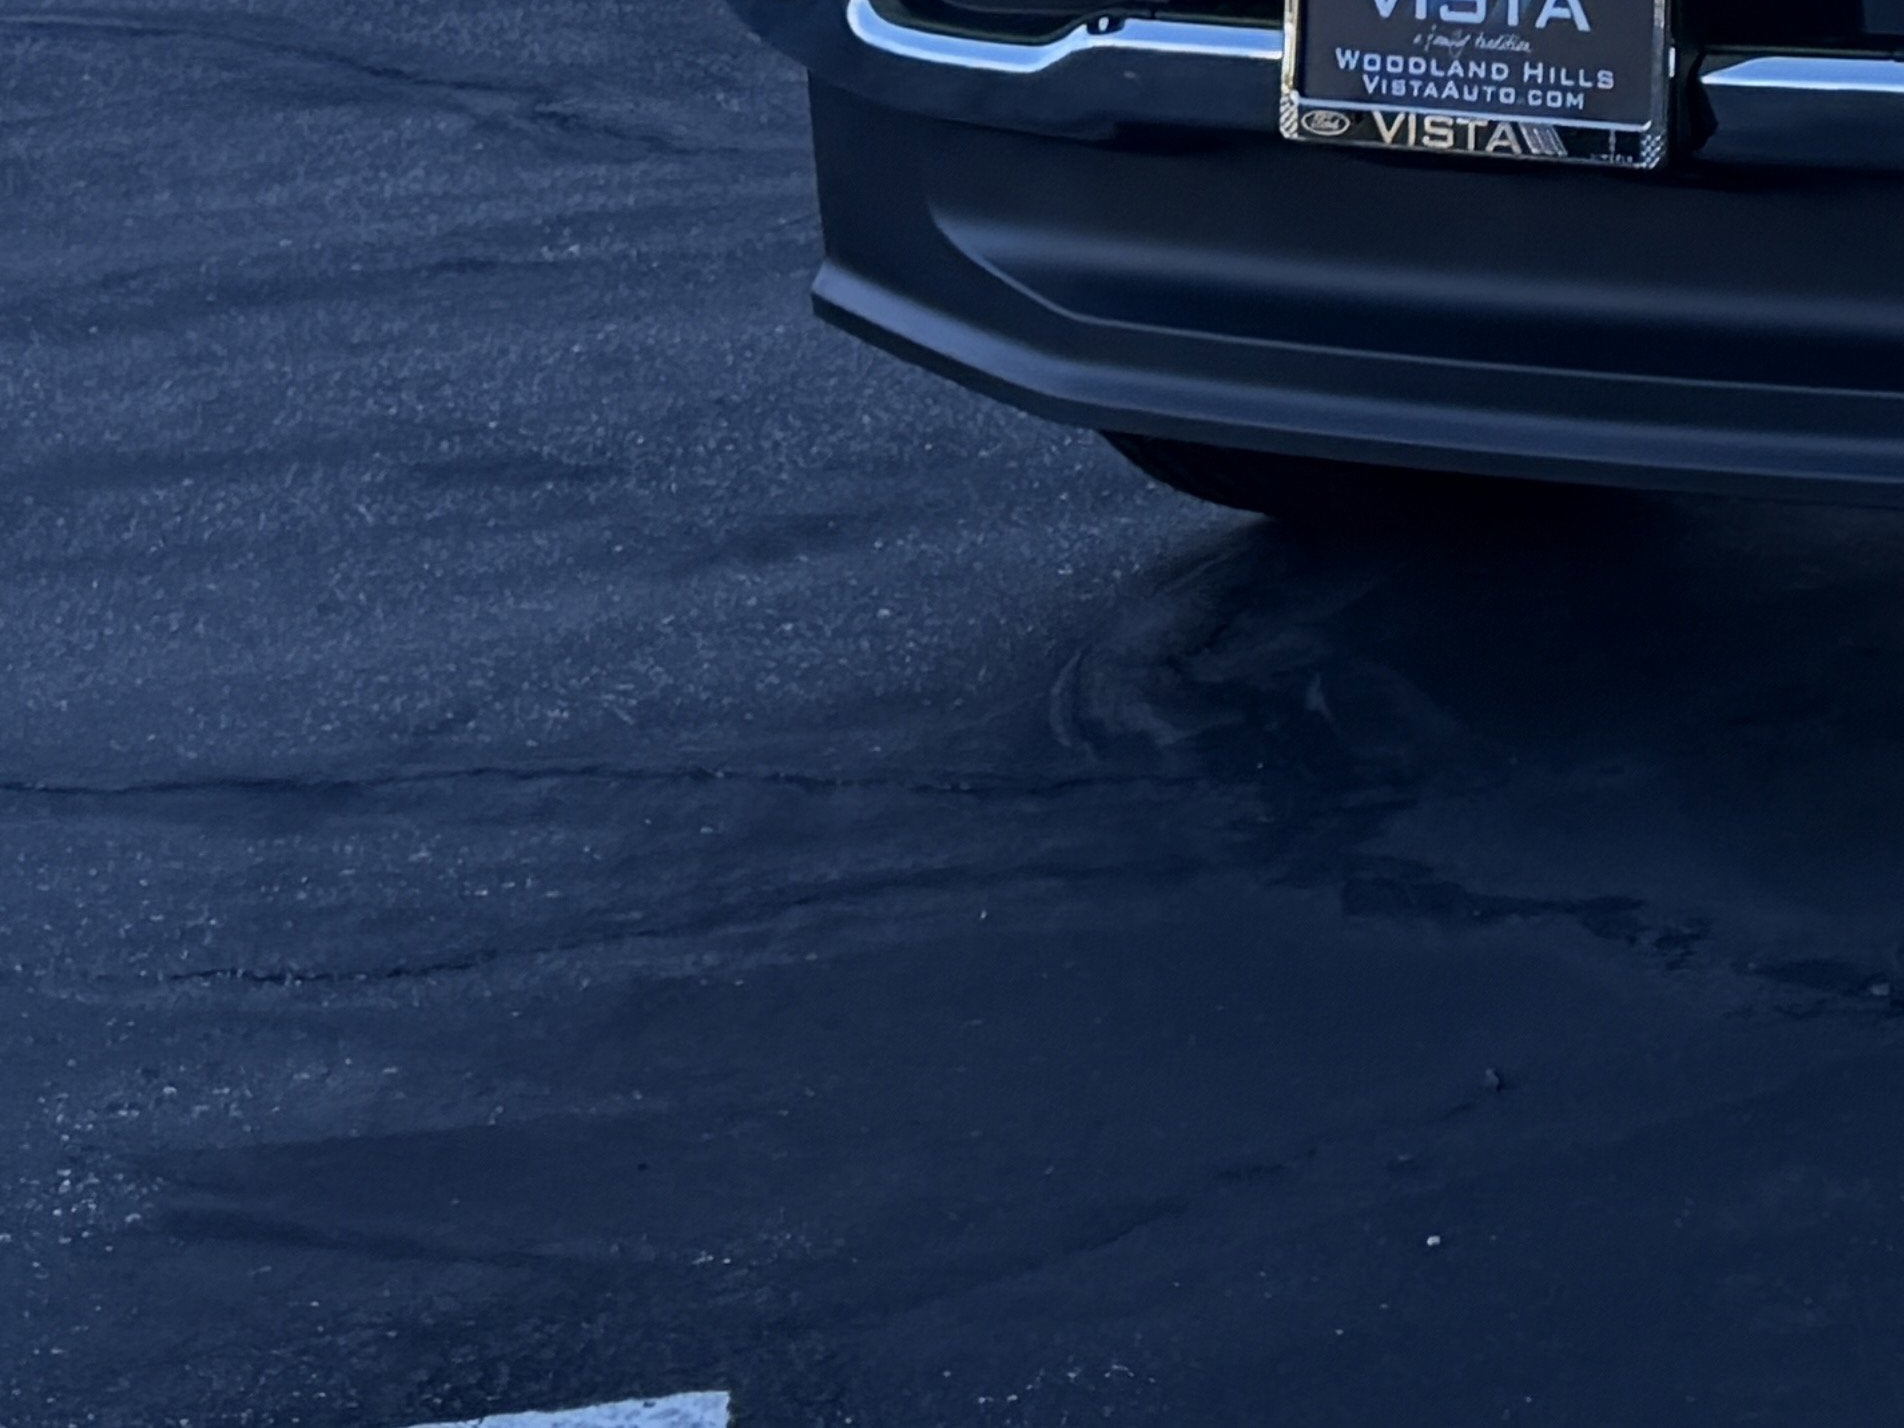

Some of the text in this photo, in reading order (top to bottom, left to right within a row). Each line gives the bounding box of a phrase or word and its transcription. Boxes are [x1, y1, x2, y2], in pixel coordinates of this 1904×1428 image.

[1334, 47, 1615, 90] WOODLAND HILLS
[1371, 111, 1522, 155] VISTA
